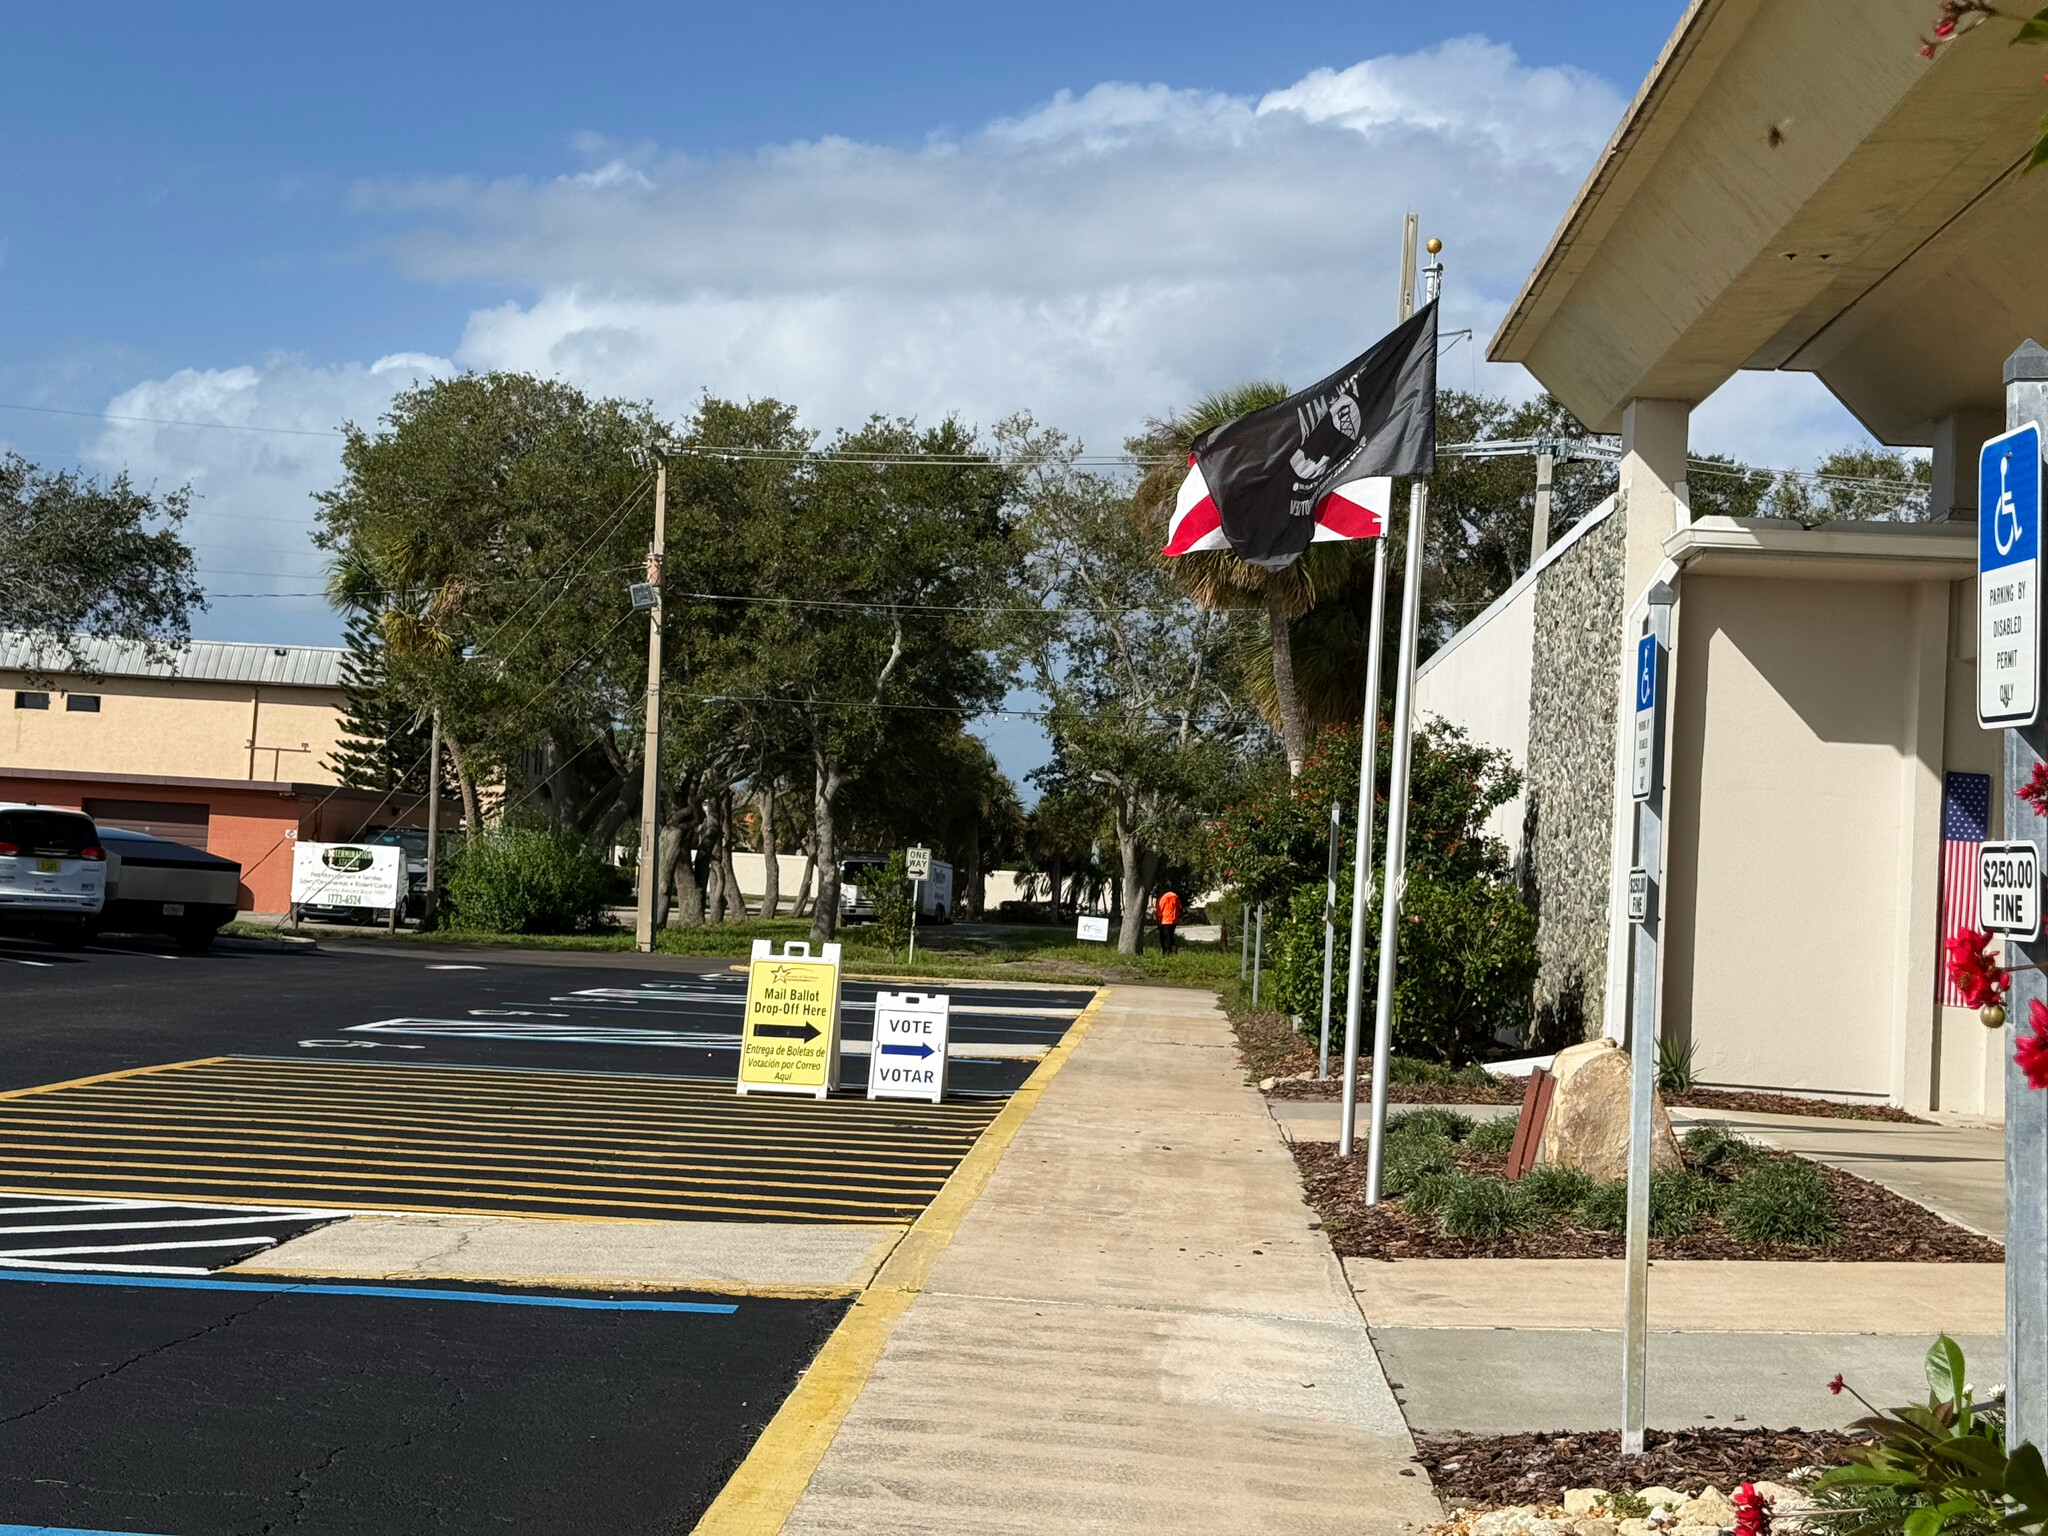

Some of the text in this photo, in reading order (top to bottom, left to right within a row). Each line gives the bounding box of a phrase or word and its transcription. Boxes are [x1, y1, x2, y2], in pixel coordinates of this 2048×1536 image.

[1989, 580, 2026, 607] PARKING BY
[1993, 615, 2022, 638] DISABLED
[1996, 649, 2018, 670] PERMIT
[1999, 683, 2014, 702] ONLY
[910, 850, 928, 859] ONE
[909, 860, 928, 868] WAY
[1983, 859, 2033, 891] $250.00
[1993, 894, 2023, 922] FINE
[764, 987, 819, 1002] Mail Ballot
[754, 1002, 827, 1017] Drop-Off Here
[889, 1019, 933, 1034] VOTE
[746, 1043, 825, 1057] Entrega de Boletas de
[748, 1057, 821, 1071] Votación por Correo
[774, 1071, 792, 1083] Aquí
[880, 1068, 934, 1084] VOTAR
